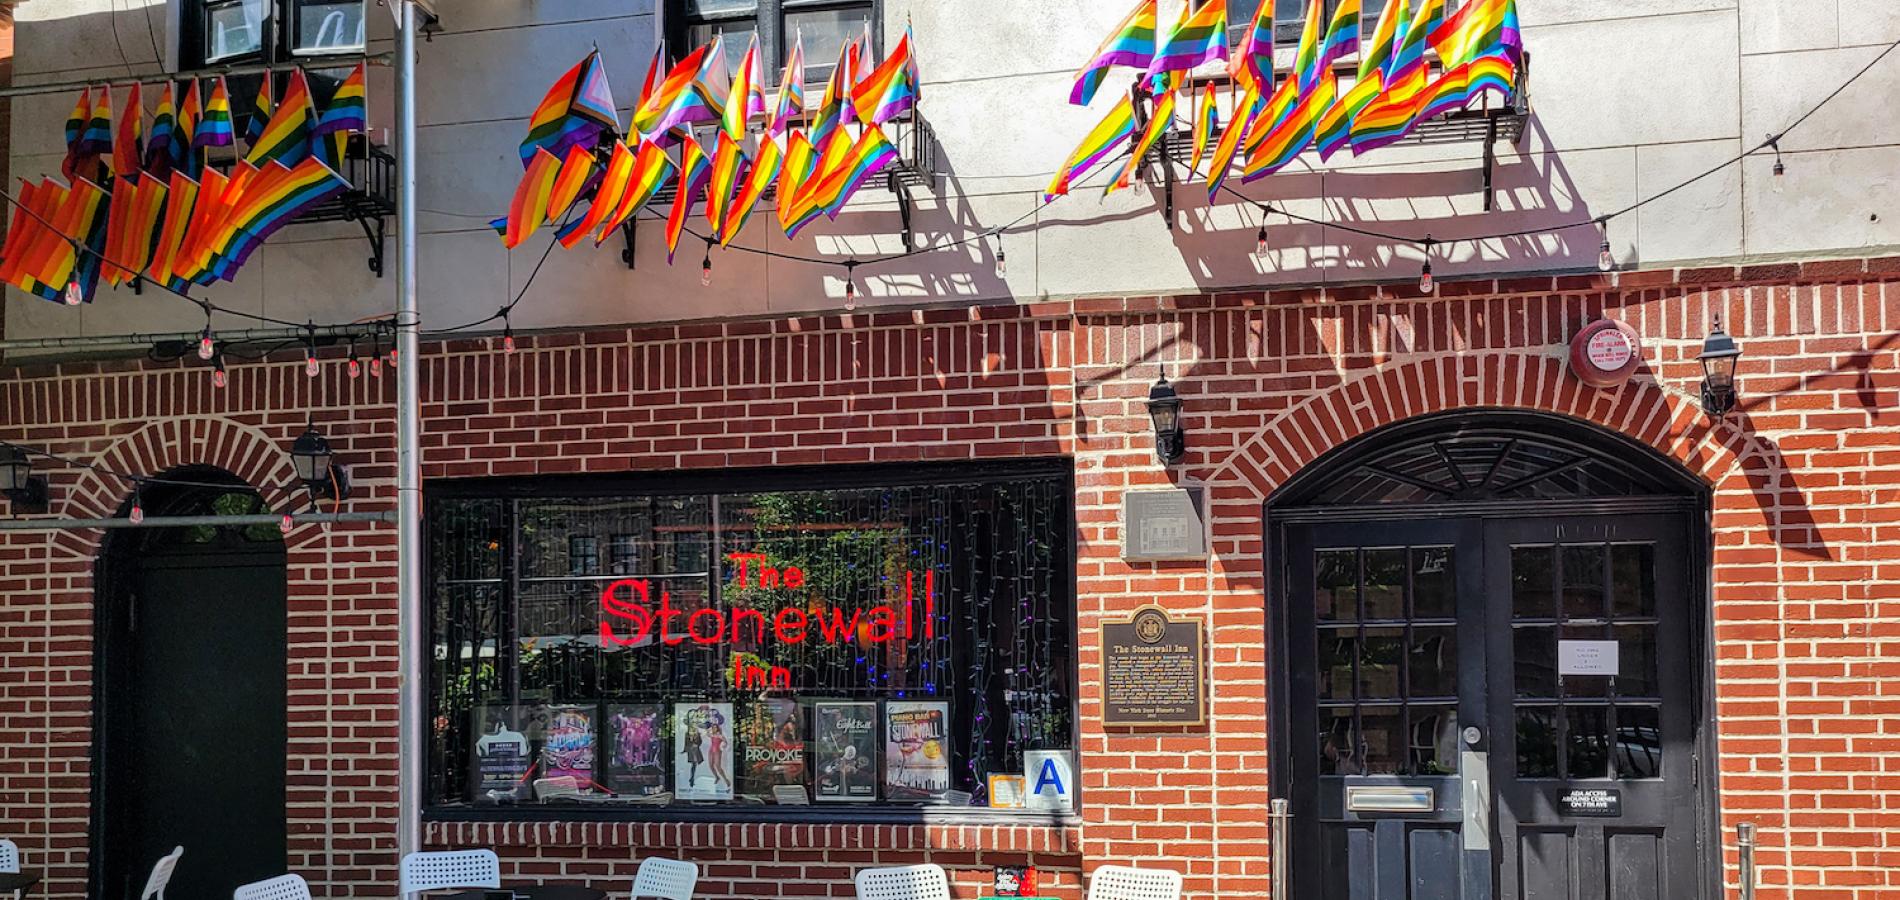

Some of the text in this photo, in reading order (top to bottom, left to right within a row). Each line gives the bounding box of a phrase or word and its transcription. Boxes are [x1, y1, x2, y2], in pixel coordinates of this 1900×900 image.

[728, 553, 805, 589] The
[602, 569, 934, 647] Stonewall
[1113, 644, 1189, 653] The Stonewall Inn
[735, 655, 791, 689] Inn
[745, 749, 804, 764] PROVOKE
[1034, 758, 1065, 794] A
